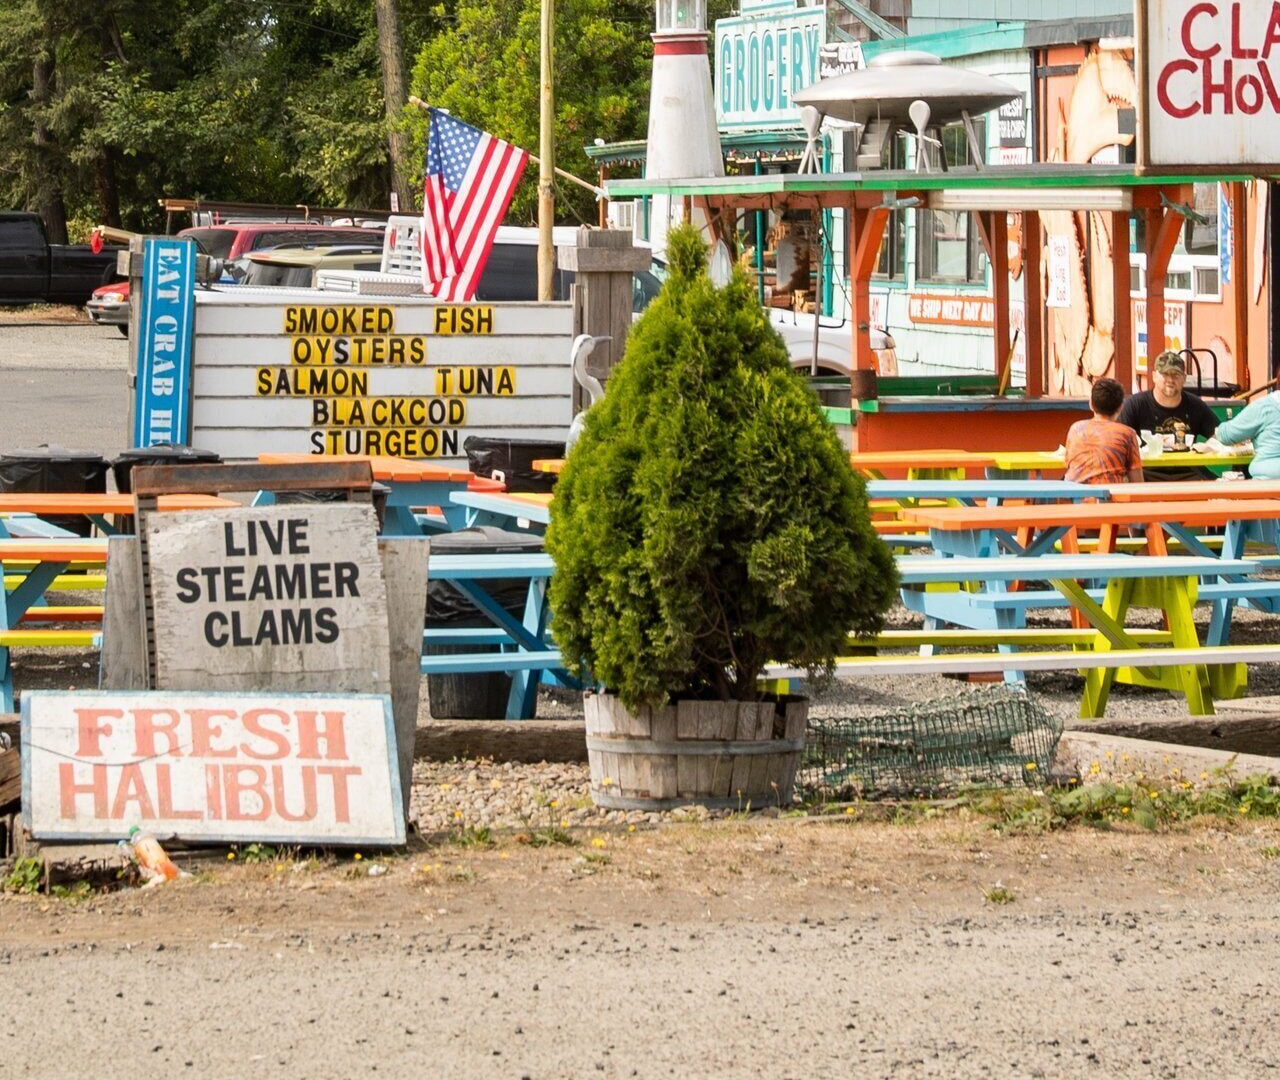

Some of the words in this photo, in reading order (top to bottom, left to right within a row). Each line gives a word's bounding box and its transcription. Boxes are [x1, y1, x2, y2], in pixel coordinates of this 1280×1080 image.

[721, 24, 819, 114] GROCERY
[157, 247, 182, 303] EAT
[286, 307, 393, 334] SMOKED
[435, 307, 493, 333] FISH
[151, 315, 178, 397] CRAB
[294, 337, 425, 364] OYSTERS
[257, 368, 368, 396] SALMON
[437, 367, 514, 394] TUNA
[314, 399, 465, 426] BLACKCOD
[311, 429, 458, 455] STURGEON
[224, 519, 311, 557] LIVE
[175, 561, 361, 604] STEAMER
[204, 606, 340, 648] CLAMS
[73, 708, 349, 761] FRESH
[58, 762, 362, 824] HALIBUT
